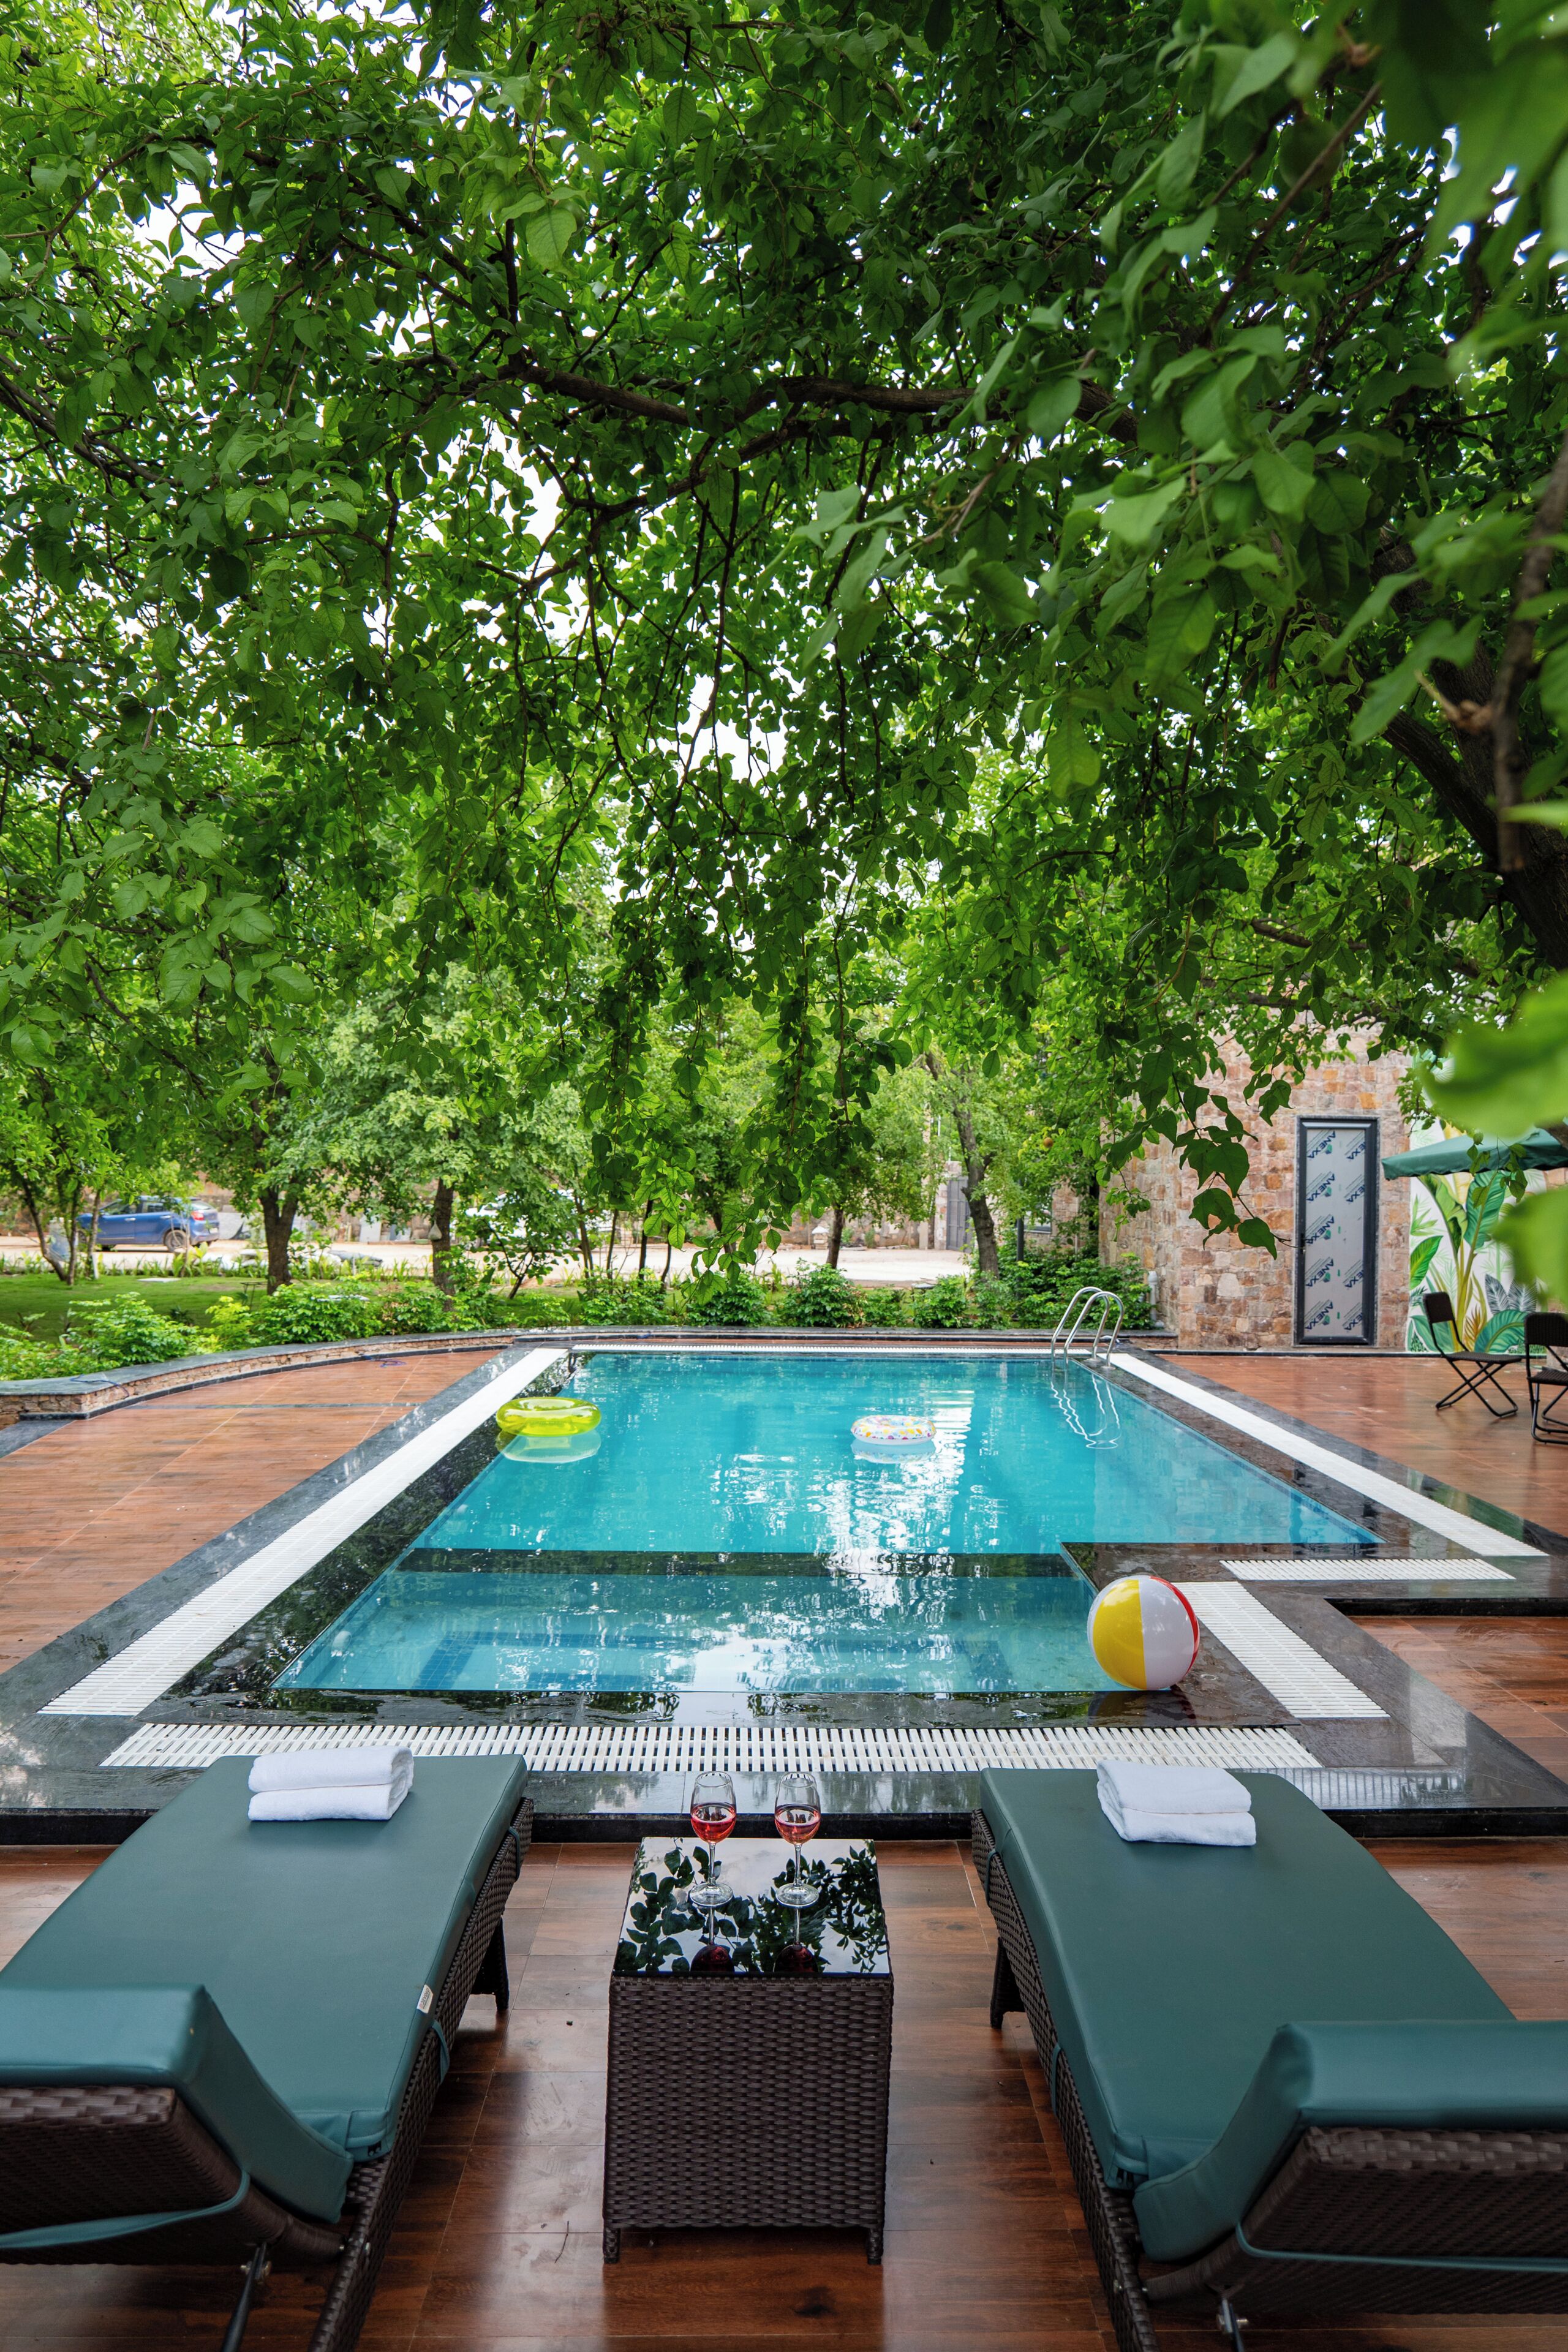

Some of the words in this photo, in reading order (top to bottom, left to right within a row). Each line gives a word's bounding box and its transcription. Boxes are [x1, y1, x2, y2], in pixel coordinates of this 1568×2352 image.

[1306, 1130, 1335, 1158] ANEXA
[1346, 1142, 1365, 1159] EXA
[1306, 1173, 1335, 1201] ANEXA
[1346, 1185, 1365, 1202] EXA
[1305, 1216, 1334, 1244] ANEXA
[1305, 1259, 1333, 1287] ANEXA
[1344, 1269, 1363, 1287] EXA
[1305, 1302, 1333, 1330] ANEXA
[1344, 1312, 1362, 1330] EXA
